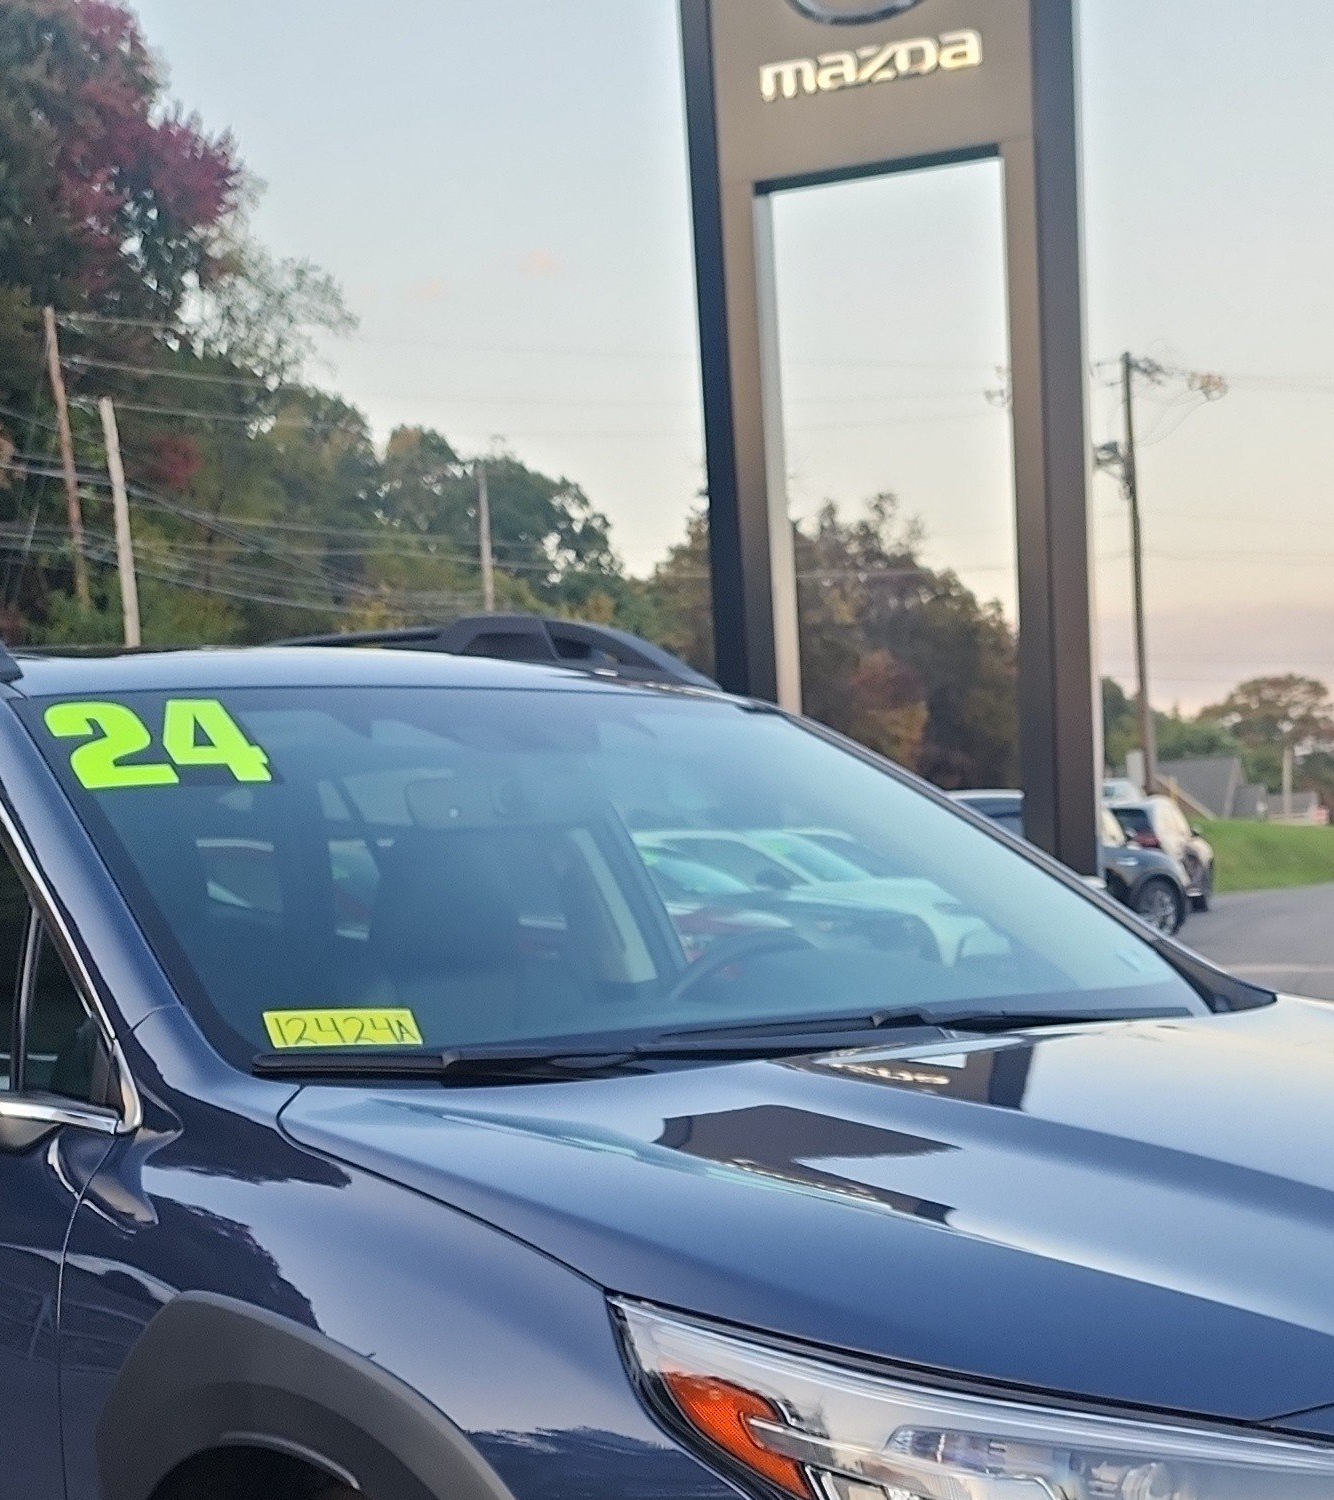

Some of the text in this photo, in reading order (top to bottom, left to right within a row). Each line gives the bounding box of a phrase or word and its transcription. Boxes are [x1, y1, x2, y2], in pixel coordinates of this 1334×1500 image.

[759, 29, 983, 102] mazda
[44, 699, 272, 788] 24
[274, 1017, 417, 1046] 12424A
